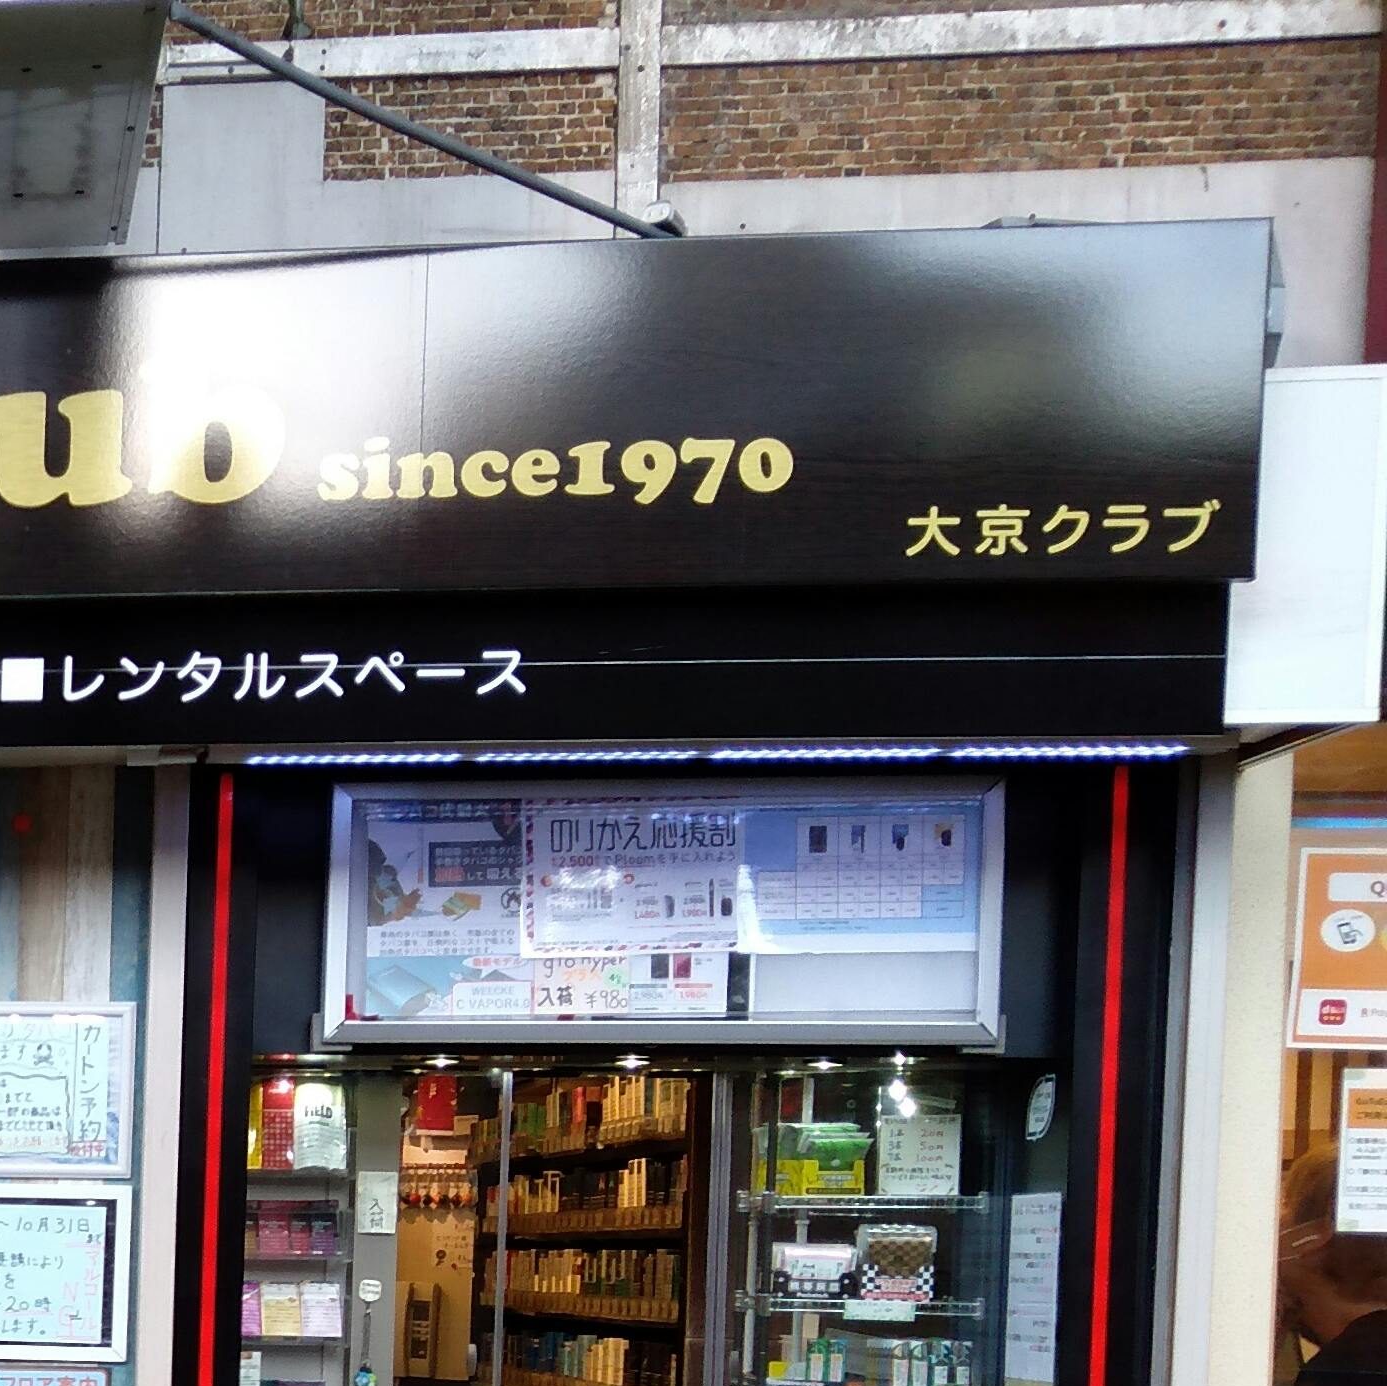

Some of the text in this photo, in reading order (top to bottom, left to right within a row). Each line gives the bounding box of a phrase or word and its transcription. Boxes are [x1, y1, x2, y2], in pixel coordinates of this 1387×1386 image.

[318, 436, 794, 504] since1970
[905, 500, 1221, 557] 大京クラブ
[61, 648, 529, 705] レンタルスペース
[550, 814, 737, 853] のりかえ応援割
[537, 986, 574, 1008] 入荷
